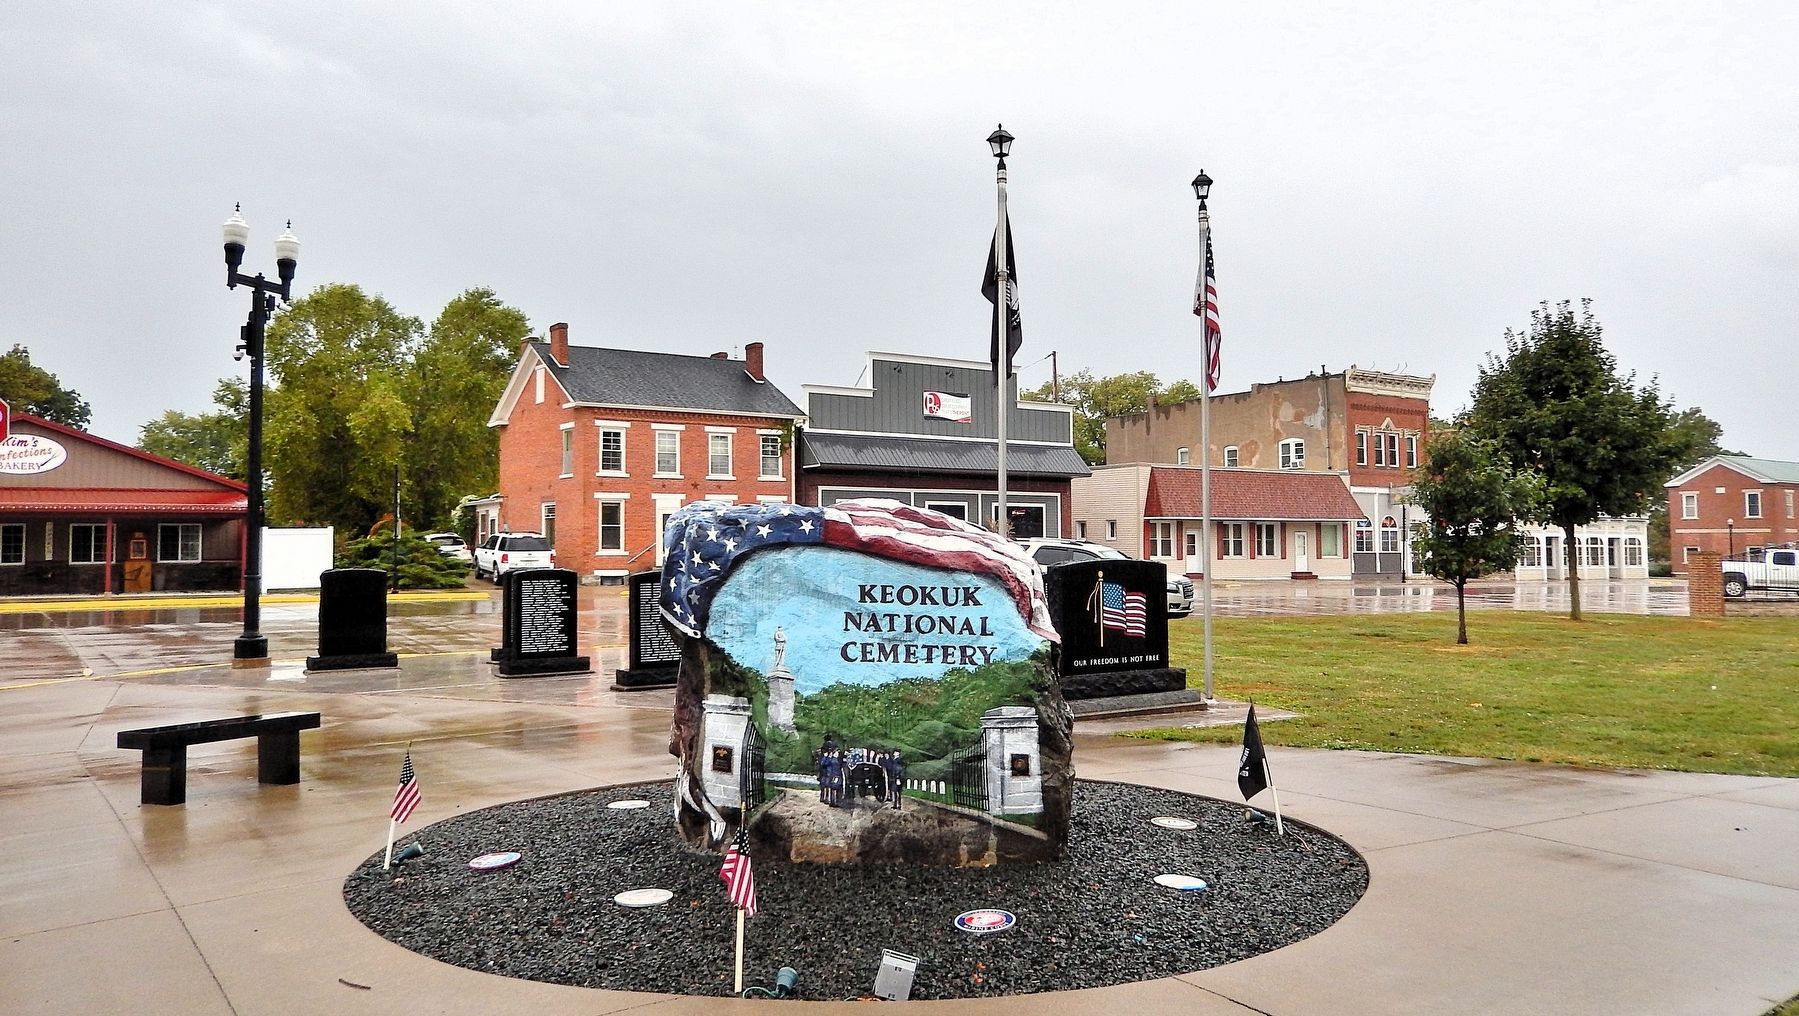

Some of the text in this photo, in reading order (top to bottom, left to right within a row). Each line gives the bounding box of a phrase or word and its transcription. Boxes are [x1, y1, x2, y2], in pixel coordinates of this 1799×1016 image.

[858, 584, 983, 607] KEOKUK
[843, 611, 994, 636] NATIONAL
[840, 641, 998, 666] CEMETERY
[1073, 654, 1160, 667] OUR FREEDOM IS NOT FREE
